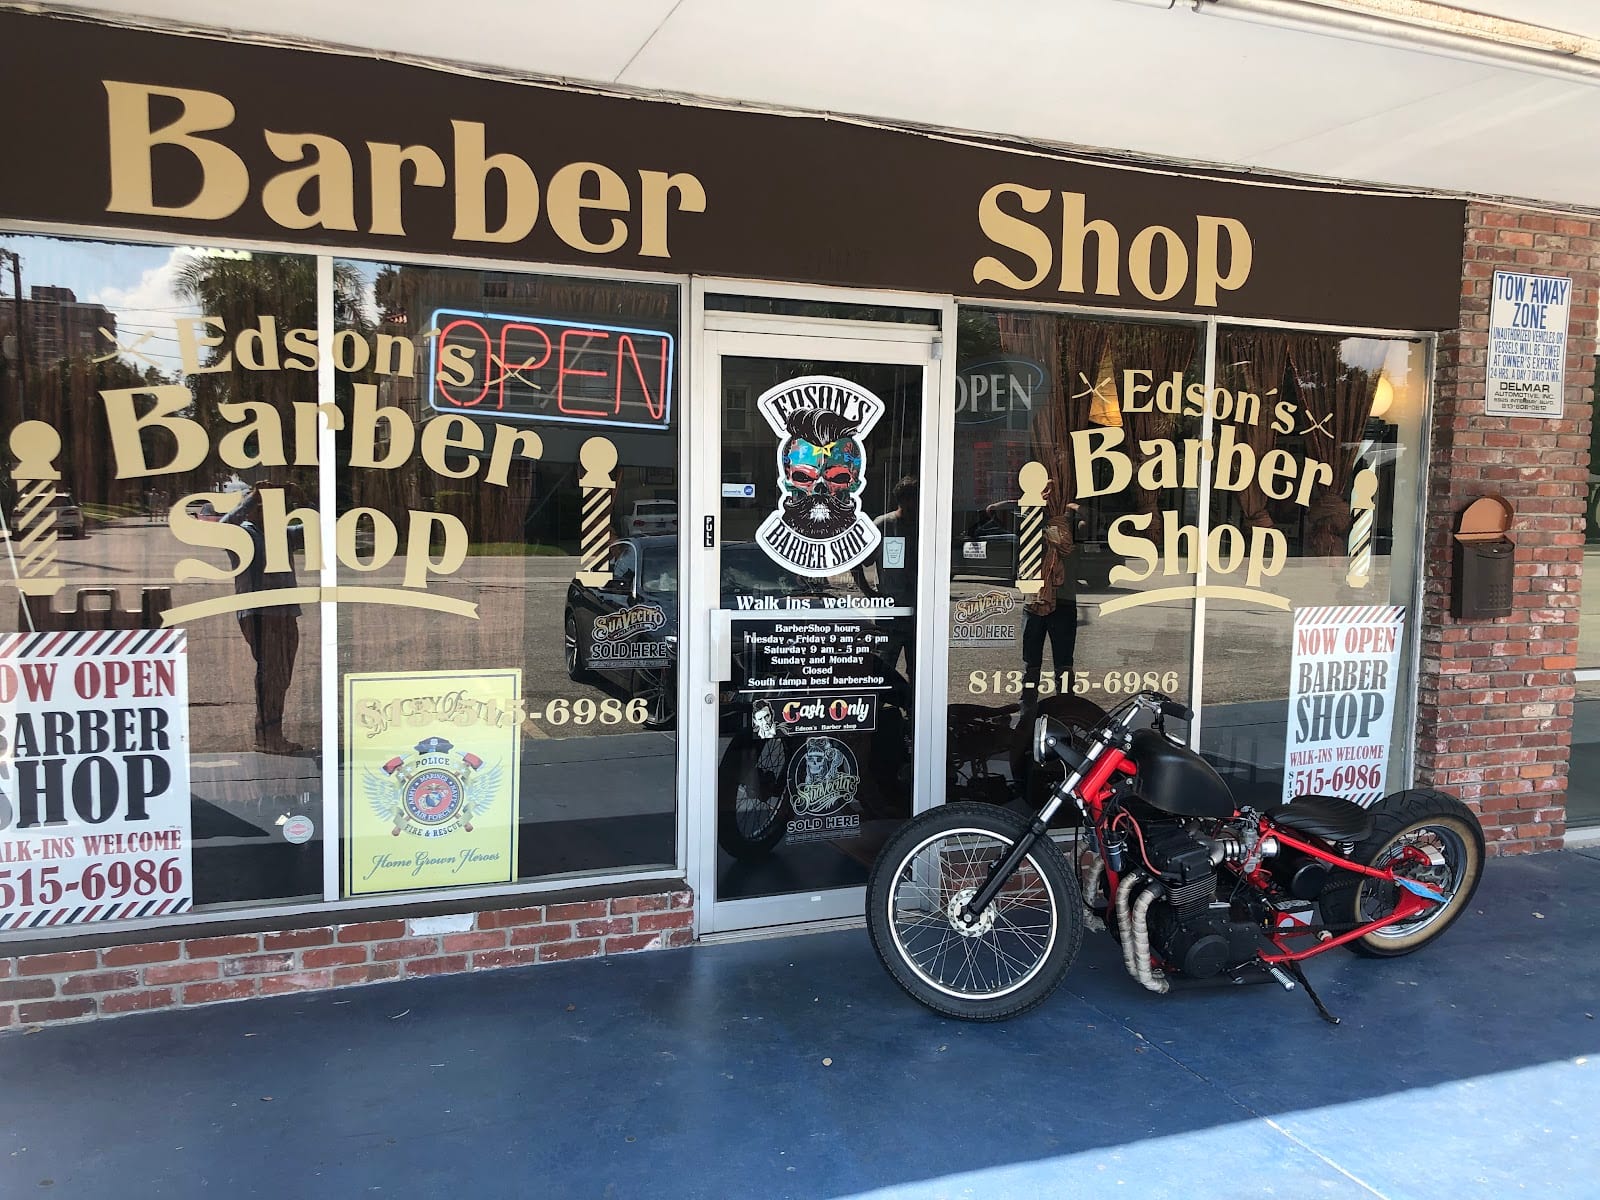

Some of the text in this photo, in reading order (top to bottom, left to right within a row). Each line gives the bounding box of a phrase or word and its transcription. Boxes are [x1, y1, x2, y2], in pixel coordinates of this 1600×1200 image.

[102, 80, 707, 258] Barber
[973, 183, 1254, 307] Shop
[1498, 274, 1568, 305] TOW AWAY
[1512, 303, 1548, 329] ZONE
[1493, 327, 1531, 342] UNAUTHORIZED
[1532, 330, 1555, 344] VEHICLES
[1494, 341, 1561, 357] VESSELS WILL BE TOWED
[438, 319, 667, 419] OPEN
[1490, 368, 1497, 378] 24
[1516, 369, 1526, 380] DAY
[1532, 371, 1545, 381] DAYS
[1493, 355, 1560, 370] AT OWNER'S EXPENSE
[1499, 381, 1550, 393] DELMAR
[771, 386, 871, 425] EDSON'S
[98, 383, 544, 487] Barber
[1070, 424, 1333, 507] Barber
[169, 488, 469, 589] Shop
[705, 517, 713, 546] PULL
[766, 522, 869, 569] BARBER SHOP
[1107, 510, 1288, 587] Shop
[735, 594, 895, 610] Walk ins welcome
[744, 634, 784, 644] Tuesday
[795, 634, 826, 644] Friday
[829, 634, 836, 643] 9
[839, 635, 853, 643] am
[865, 634, 872, 643] 6
[875, 635, 889, 645] pm
[775, 623, 861, 634] BarberShop hours
[953, 624, 1015, 639] SOLD HERE
[1297, 626, 1398, 656] NOW OPEN
[591, 642, 667, 659] SOLD HERE
[764, 645, 806, 655] Saturday
[810, 645, 817, 654] 9
[820, 646, 835, 654] am
[846, 645, 852, 654] 5
[855, 646, 870, 656] pm
[771, 655, 864, 666] Sunday and Monday
[74, 659, 177, 701] OPEN
[748, 676, 885, 687] South tampa best barbershop
[802, 666, 833, 675] Closed
[967, 669, 1179, 694] 813-515-6986
[1298, 659, 1389, 694] BARBER
[782, 697, 870, 723] Cash Only
[1295, 691, 1385, 744] SHOP
[0, 707, 170, 758] ARBER
[415, 757, 450, 768] POLICE
[1290, 744, 1385, 768] WALK-INS WELCOME
[1294, 763, 1382, 798] 515-6986
[404, 823, 423, 836] FIRE
[433, 820, 463, 837] RESCUE
[787, 815, 860, 833] SOLD HERE
[83, 829, 182, 857] WELCOME
[363, 847, 500, 881] Home Grown Heroes
